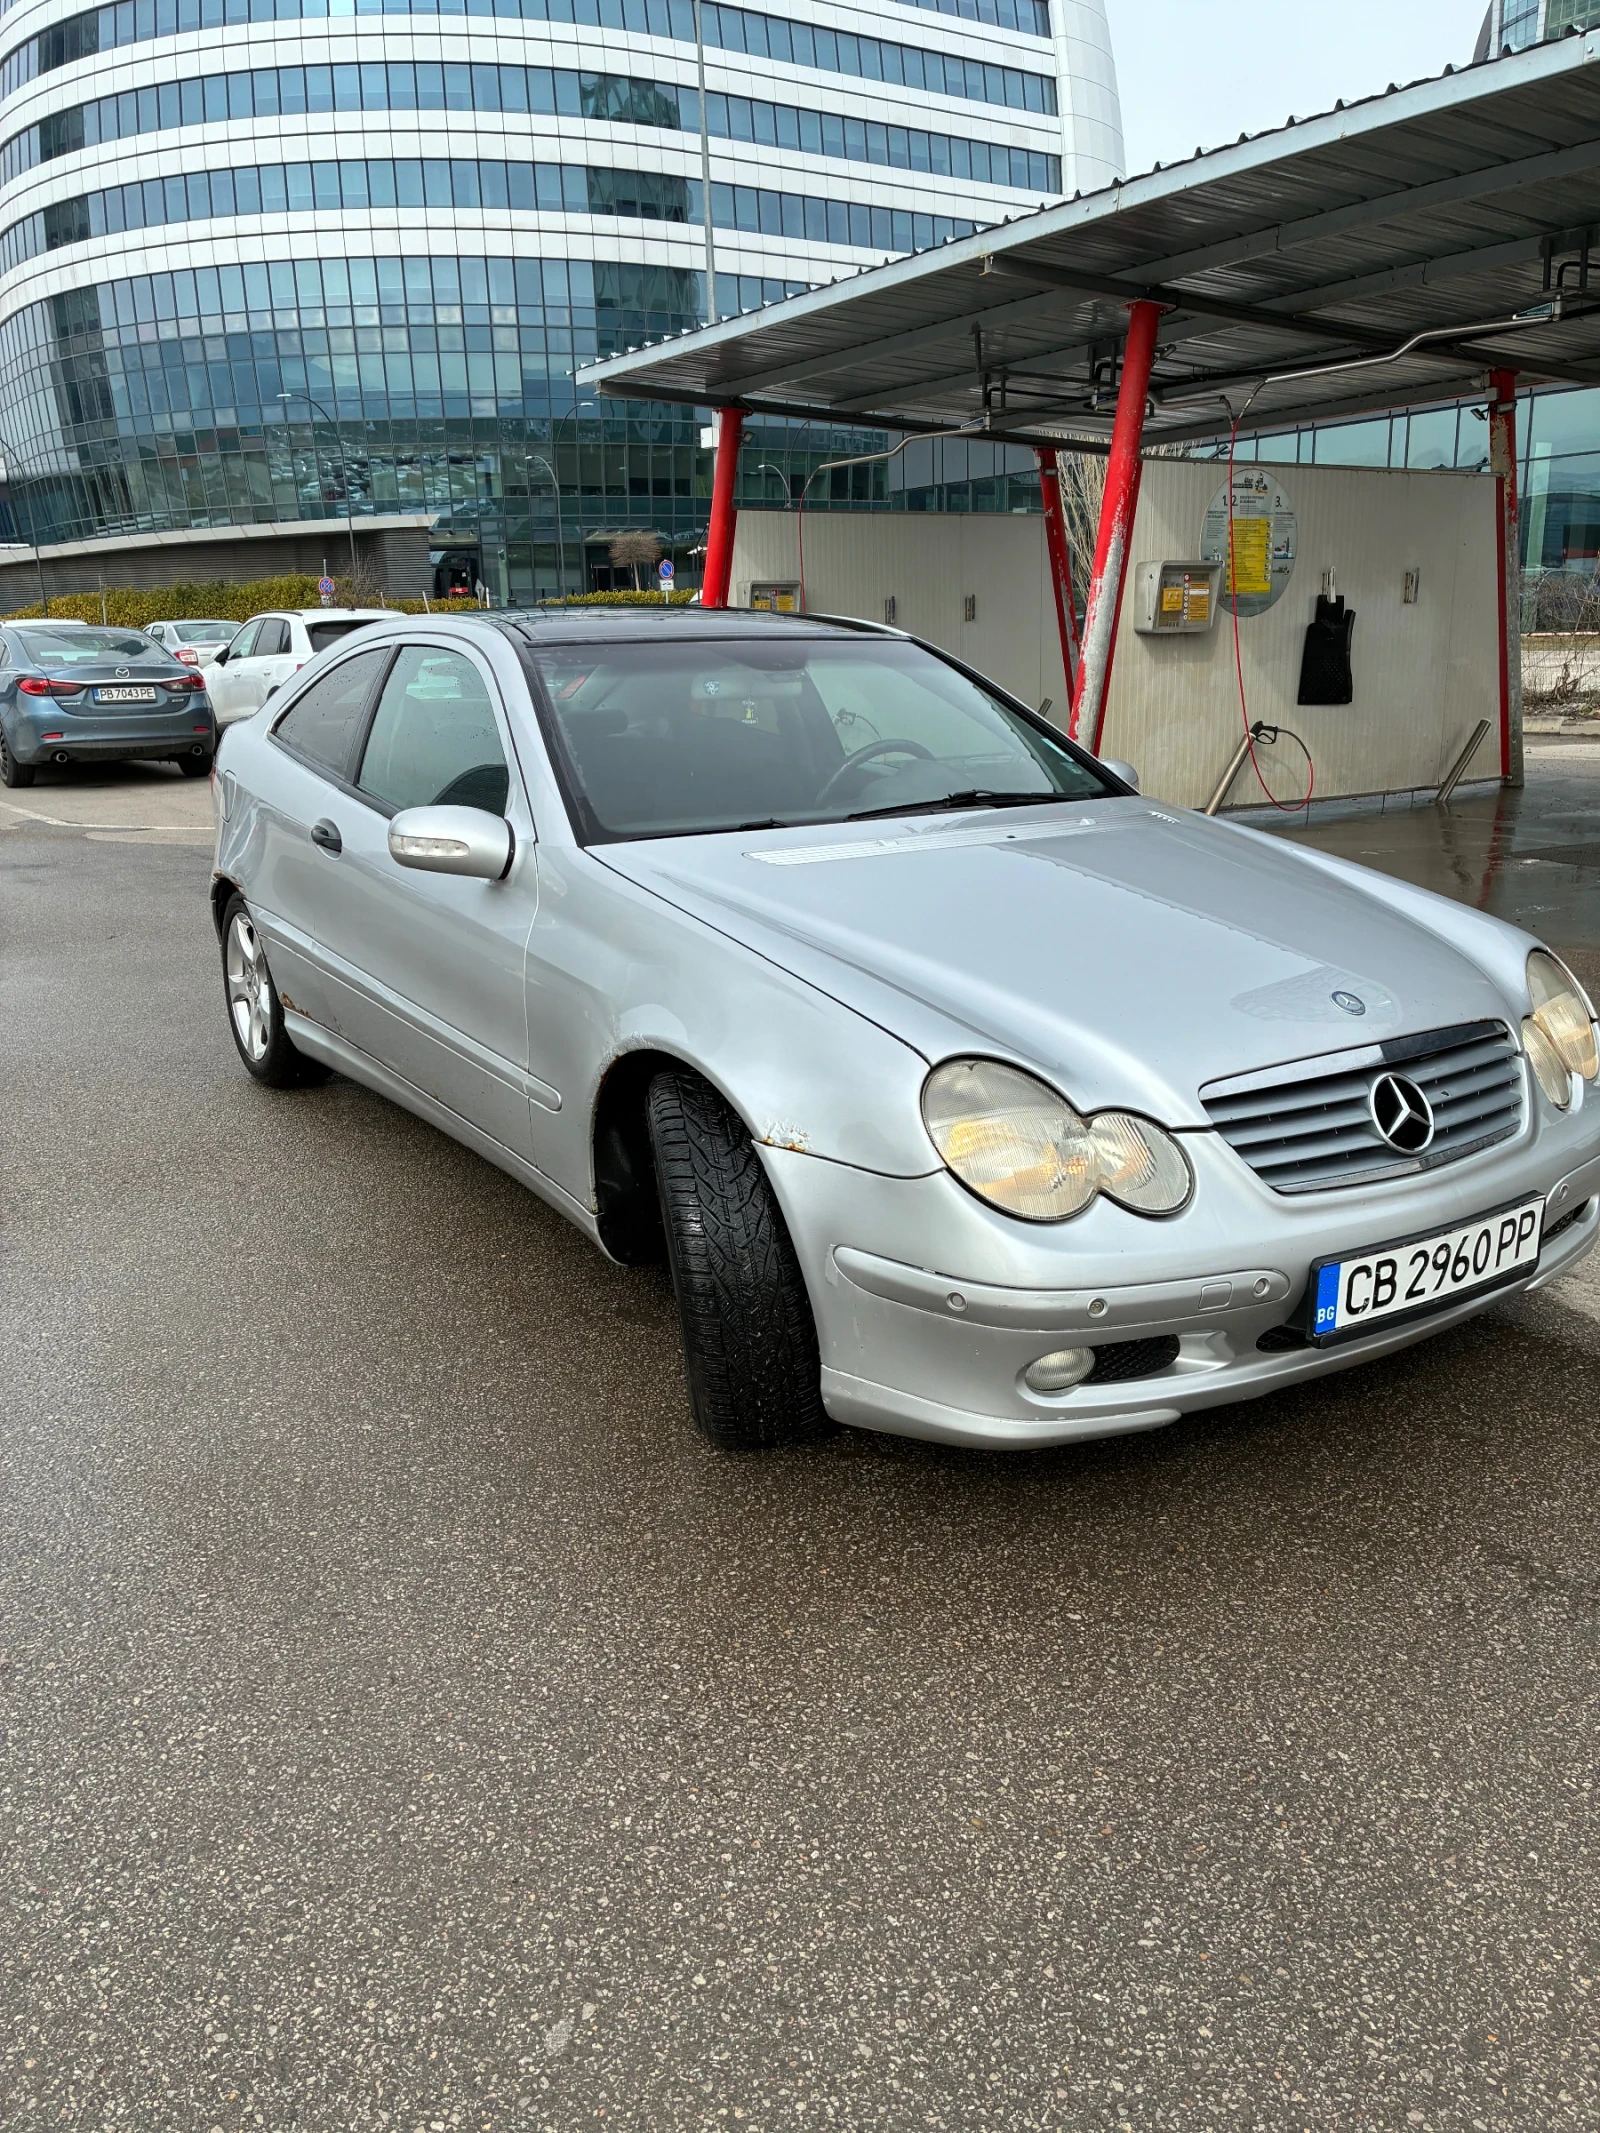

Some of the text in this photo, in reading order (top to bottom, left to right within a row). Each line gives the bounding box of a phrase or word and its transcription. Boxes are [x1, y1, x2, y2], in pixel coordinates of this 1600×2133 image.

[1275, 496, 1282, 507] 3.
[100, 690, 114, 699] PB
[115, 689, 139, 698] 7043
[140, 688, 154, 698] PE
[1317, 1210, 1536, 1324] BG CB 2960 PP
